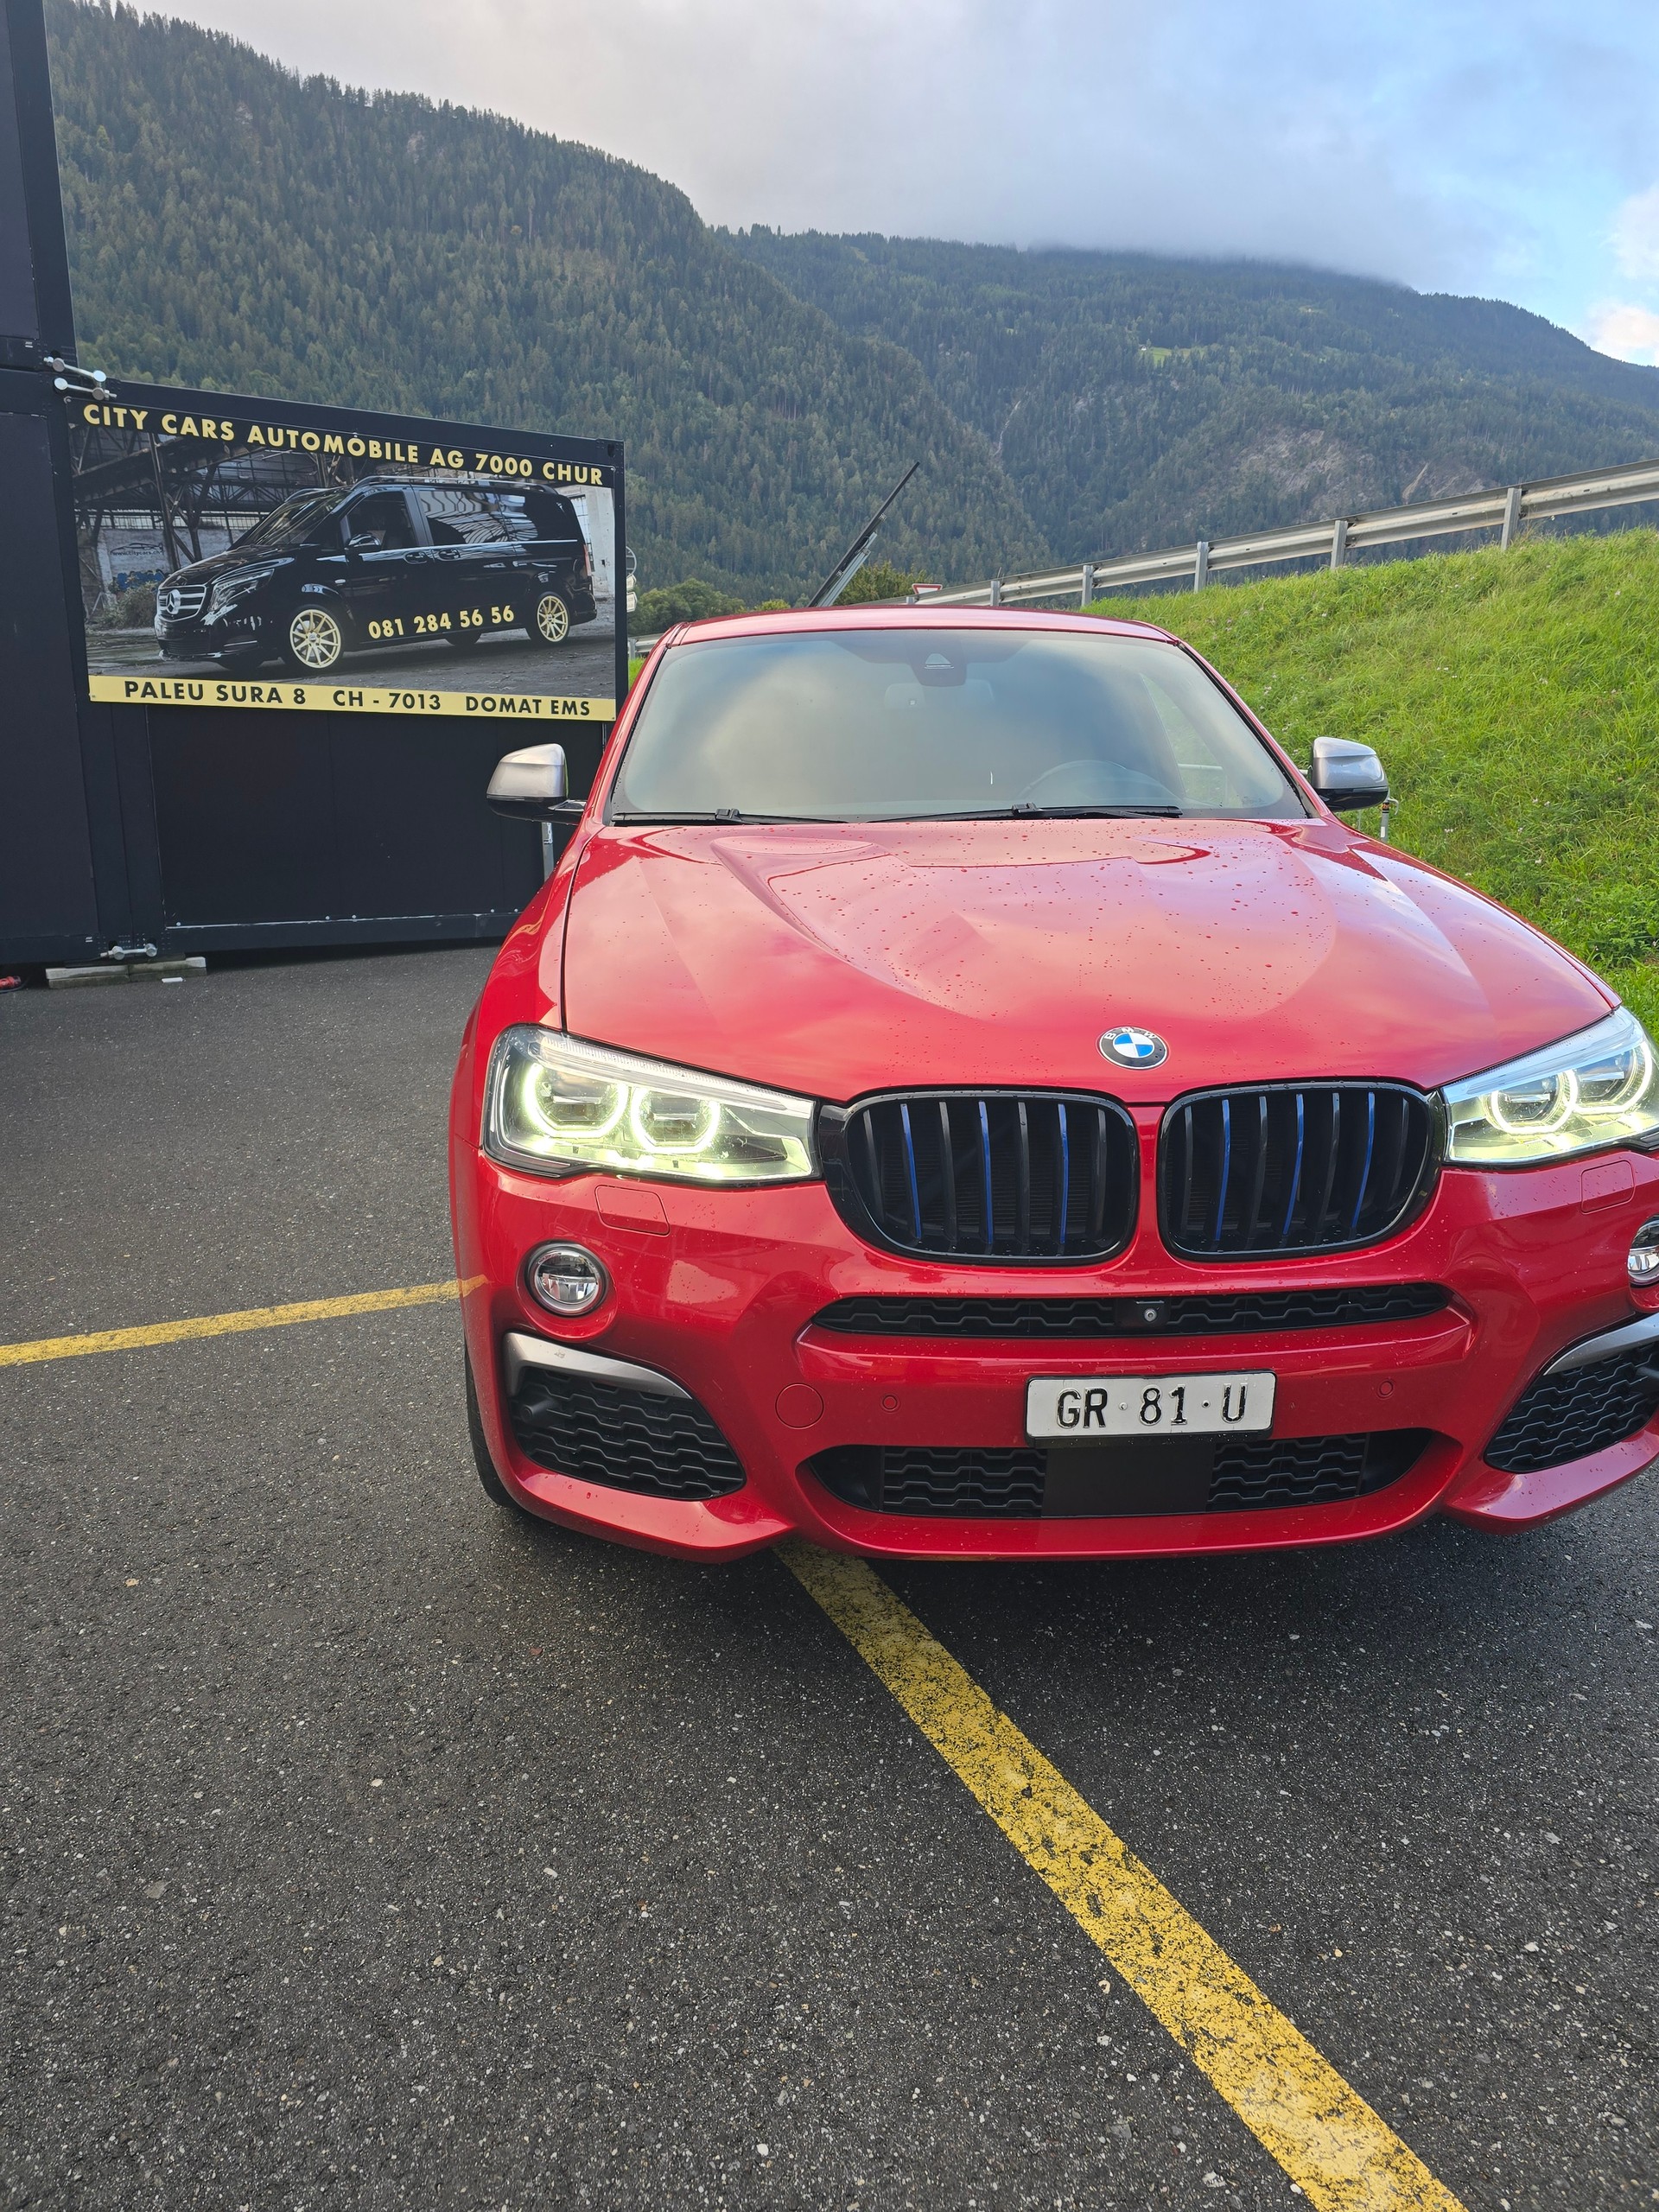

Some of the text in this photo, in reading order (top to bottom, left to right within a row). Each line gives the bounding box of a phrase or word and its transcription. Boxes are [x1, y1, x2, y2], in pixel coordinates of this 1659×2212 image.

[84, 404, 603, 486] CITY CARS AUTOMOBILE AG 7000 CHUR
[368, 605, 515, 639] 081 284 56 56
[124, 680, 204, 701] PALEU
[216, 684, 283, 704] SURA
[293, 688, 306, 705] 8
[333, 690, 364, 707] CH
[388, 692, 442, 710] 7013
[466, 696, 542, 715] DOMAT
[550, 699, 590, 716] EMS
[1103, 1027, 1157, 1040] BMW
[1056, 1382, 1248, 1428] GR 81 U
